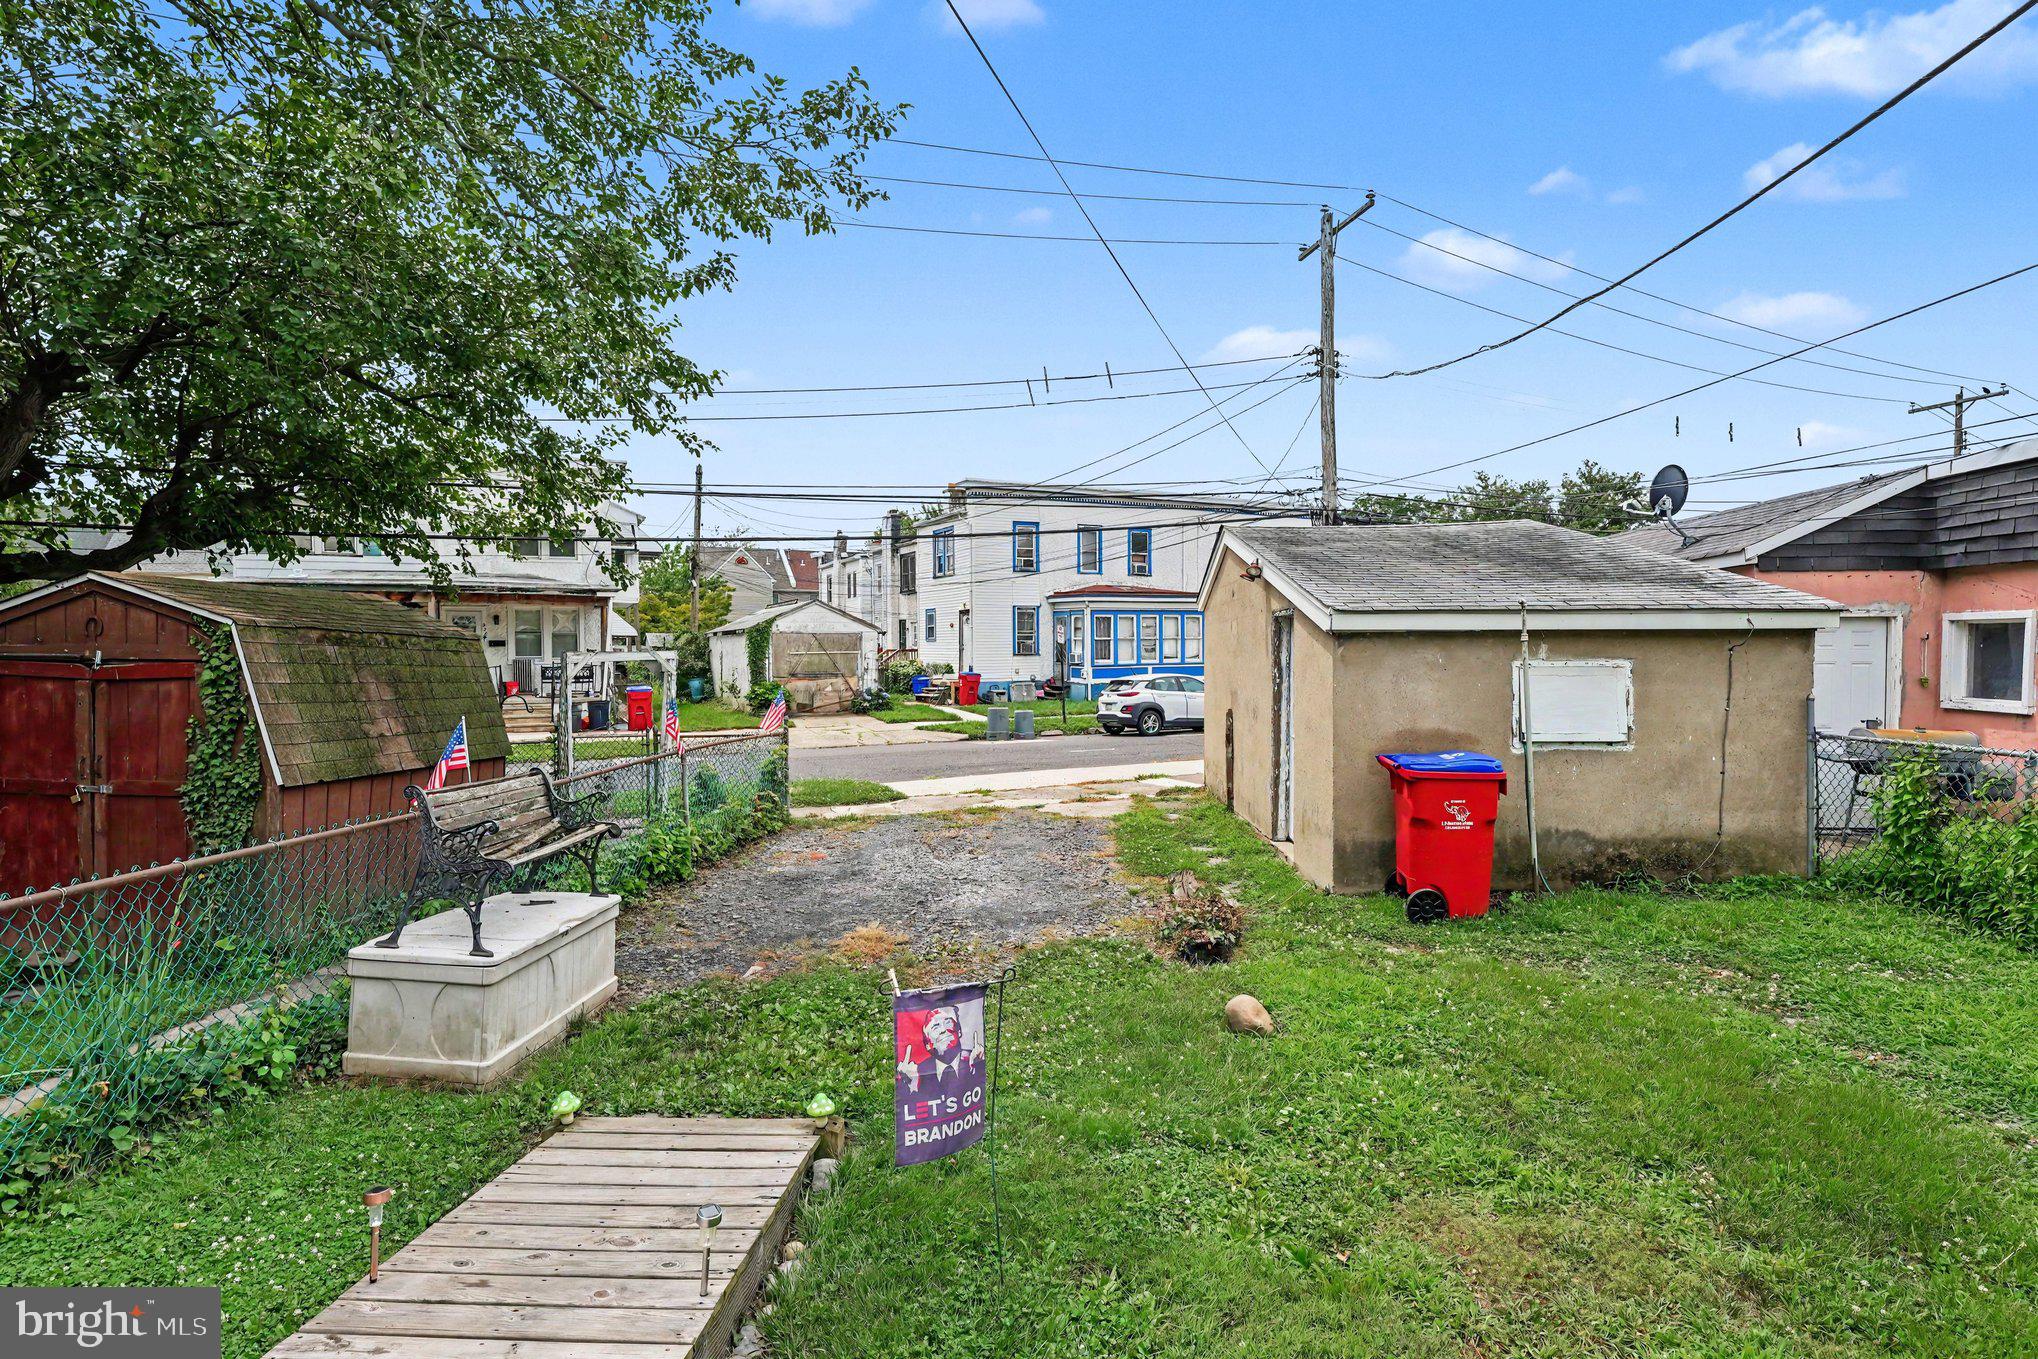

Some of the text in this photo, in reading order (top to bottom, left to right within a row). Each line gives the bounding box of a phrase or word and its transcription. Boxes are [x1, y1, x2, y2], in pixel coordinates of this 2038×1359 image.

[904, 1086, 982, 1121] LET'S GO
[904, 1109, 982, 1147] BRANDON
